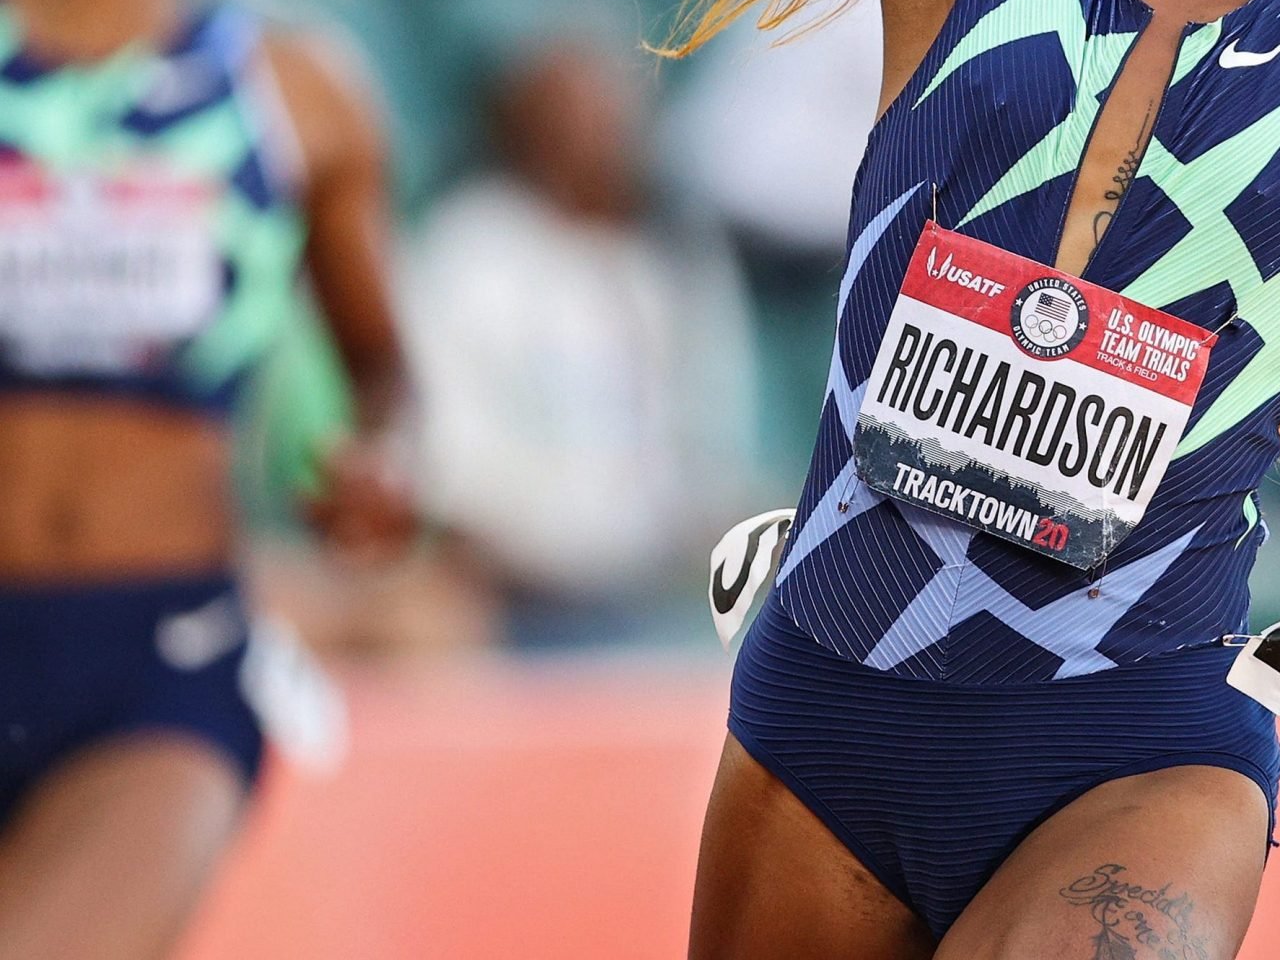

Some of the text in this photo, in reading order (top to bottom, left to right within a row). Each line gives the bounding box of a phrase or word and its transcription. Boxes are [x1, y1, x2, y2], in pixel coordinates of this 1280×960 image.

[947, 266, 1006, 298] USATF
[1028, 279, 1087, 311] UNITED STATES
[1013, 325, 1070, 356] OLYMPIC TEAM
[1107, 308, 1201, 360] U.S. OLYMPIC
[1096, 351, 1158, 381] TRACK & FIELD
[1100, 329, 1191, 382] TEAM TRIALS
[876, 323, 1167, 501] RICHARDSON
